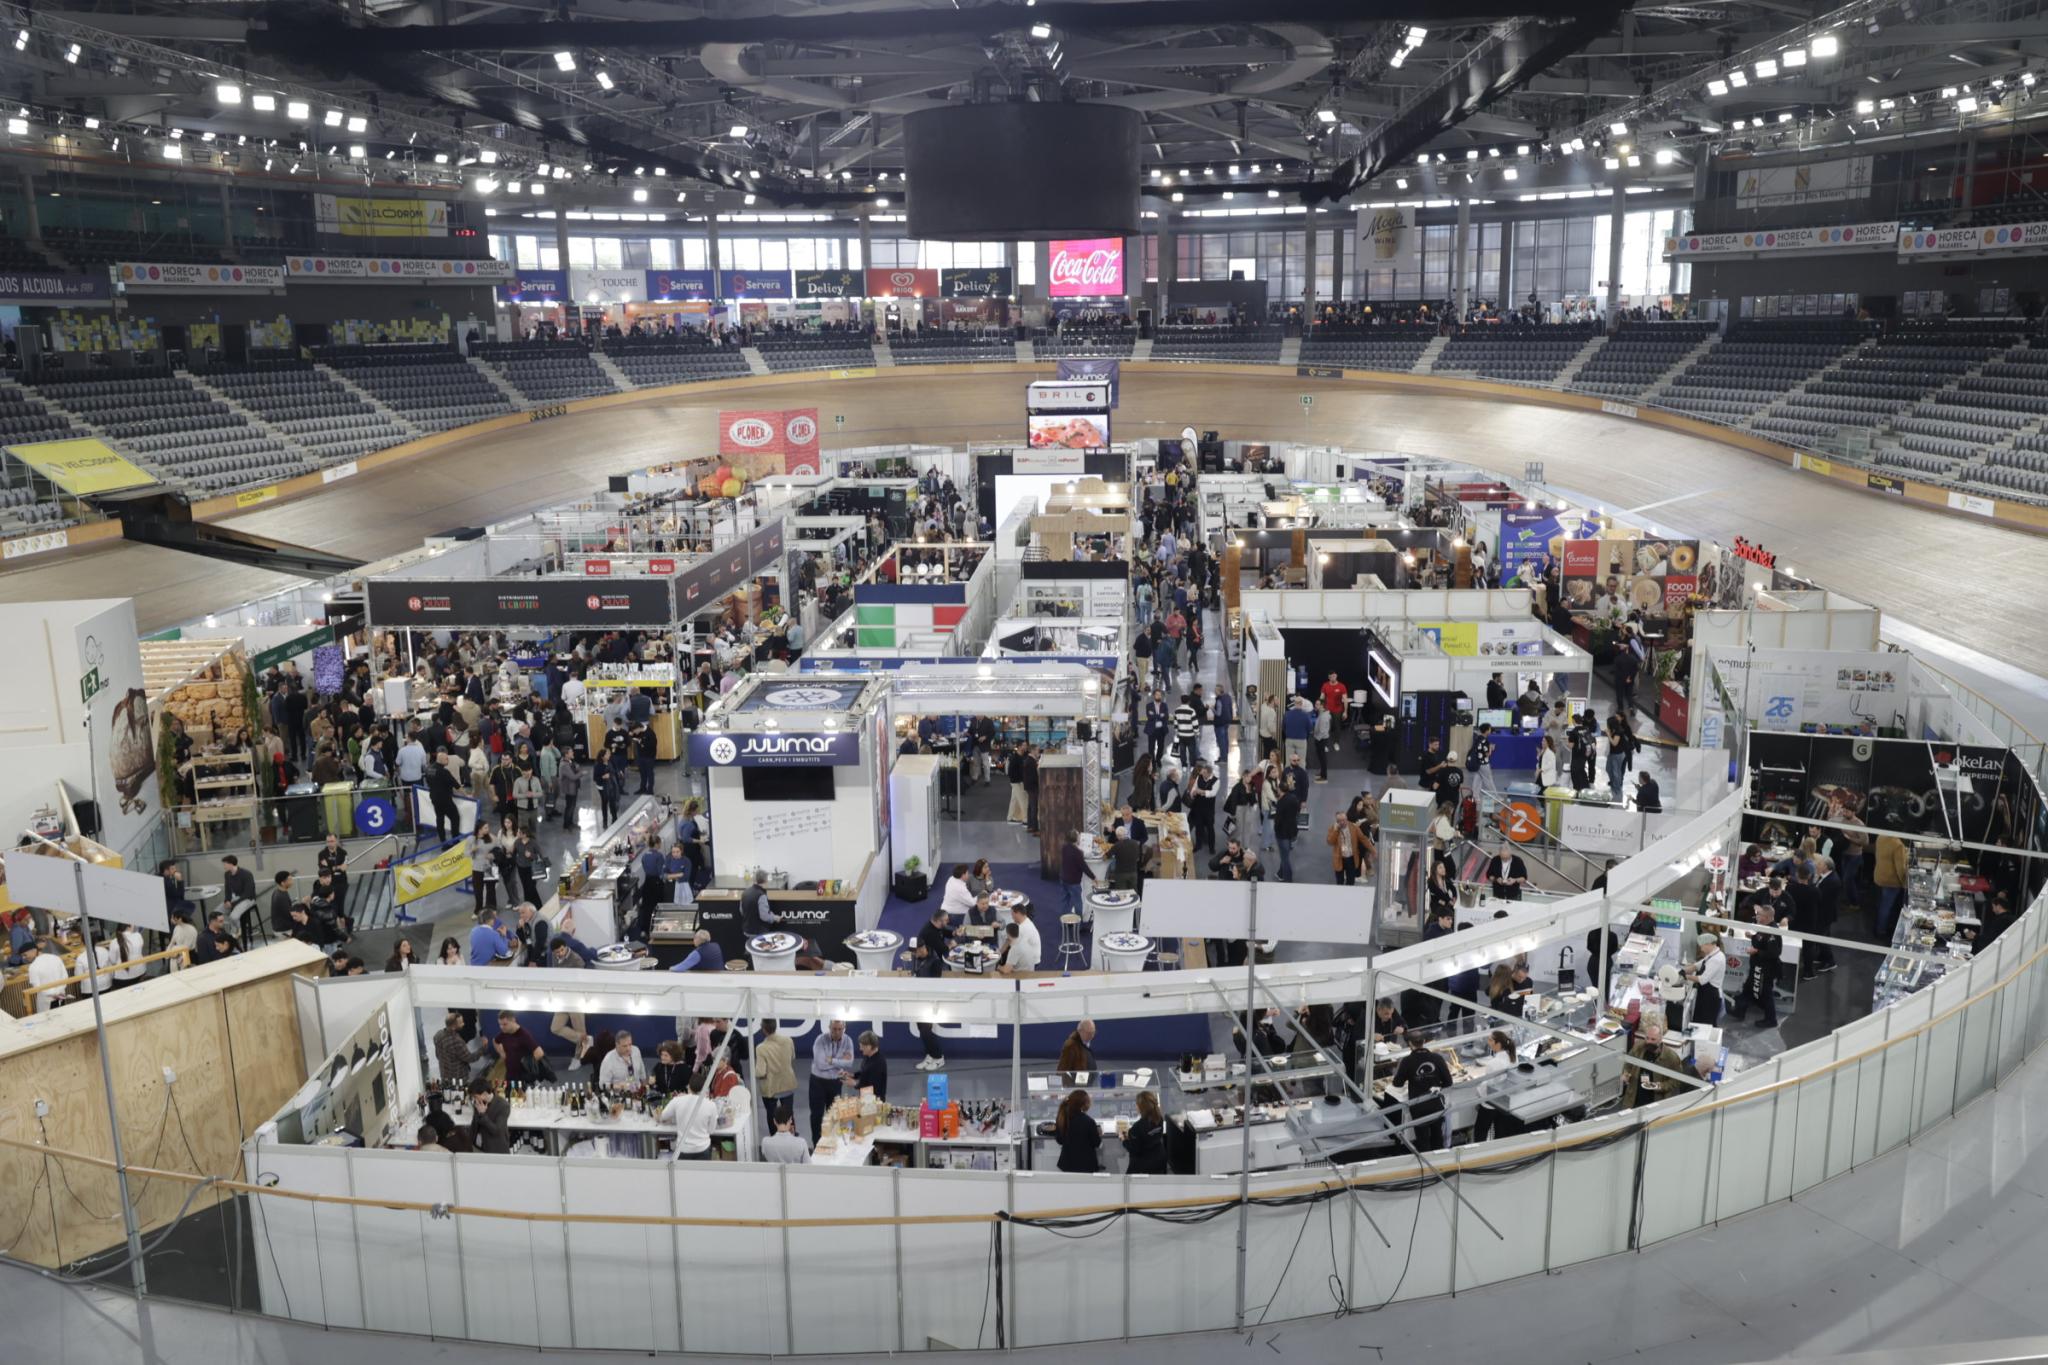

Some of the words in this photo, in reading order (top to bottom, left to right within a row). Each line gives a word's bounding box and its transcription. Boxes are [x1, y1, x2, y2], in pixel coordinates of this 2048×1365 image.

[1857, 225, 1895, 236] HORECA
[2025, 225, 2048, 236] HOR
[1702, 236, 1738, 245] HORECA
[1777, 231, 1813, 241] HORECA
[1939, 231, 1977, 242] HORECA
[328, 260, 363, 269] HORECA
[403, 261, 436, 270] HORECA
[477, 262, 510, 271] HORECA
[1049, 249, 1120, 286] Coca-Cola
[162, 266, 201, 276] HORECA
[244, 268, 280, 278] HORECA
[23, 278, 65, 294] ALCUDIA
[520, 281, 556, 291] Servera
[670, 281, 703, 290] Servera
[746, 280, 781, 290] Servera
[807, 282, 844, 296] Delicy
[953, 280, 992, 293] Delicy
[1734, 535, 1776, 569] Sánchez
[1667, 583, 1694, 592] FOOD
[1666, 596, 1687, 604] GOO
[366, 805, 384, 828] 3
[1511, 809, 1527, 833] 2
